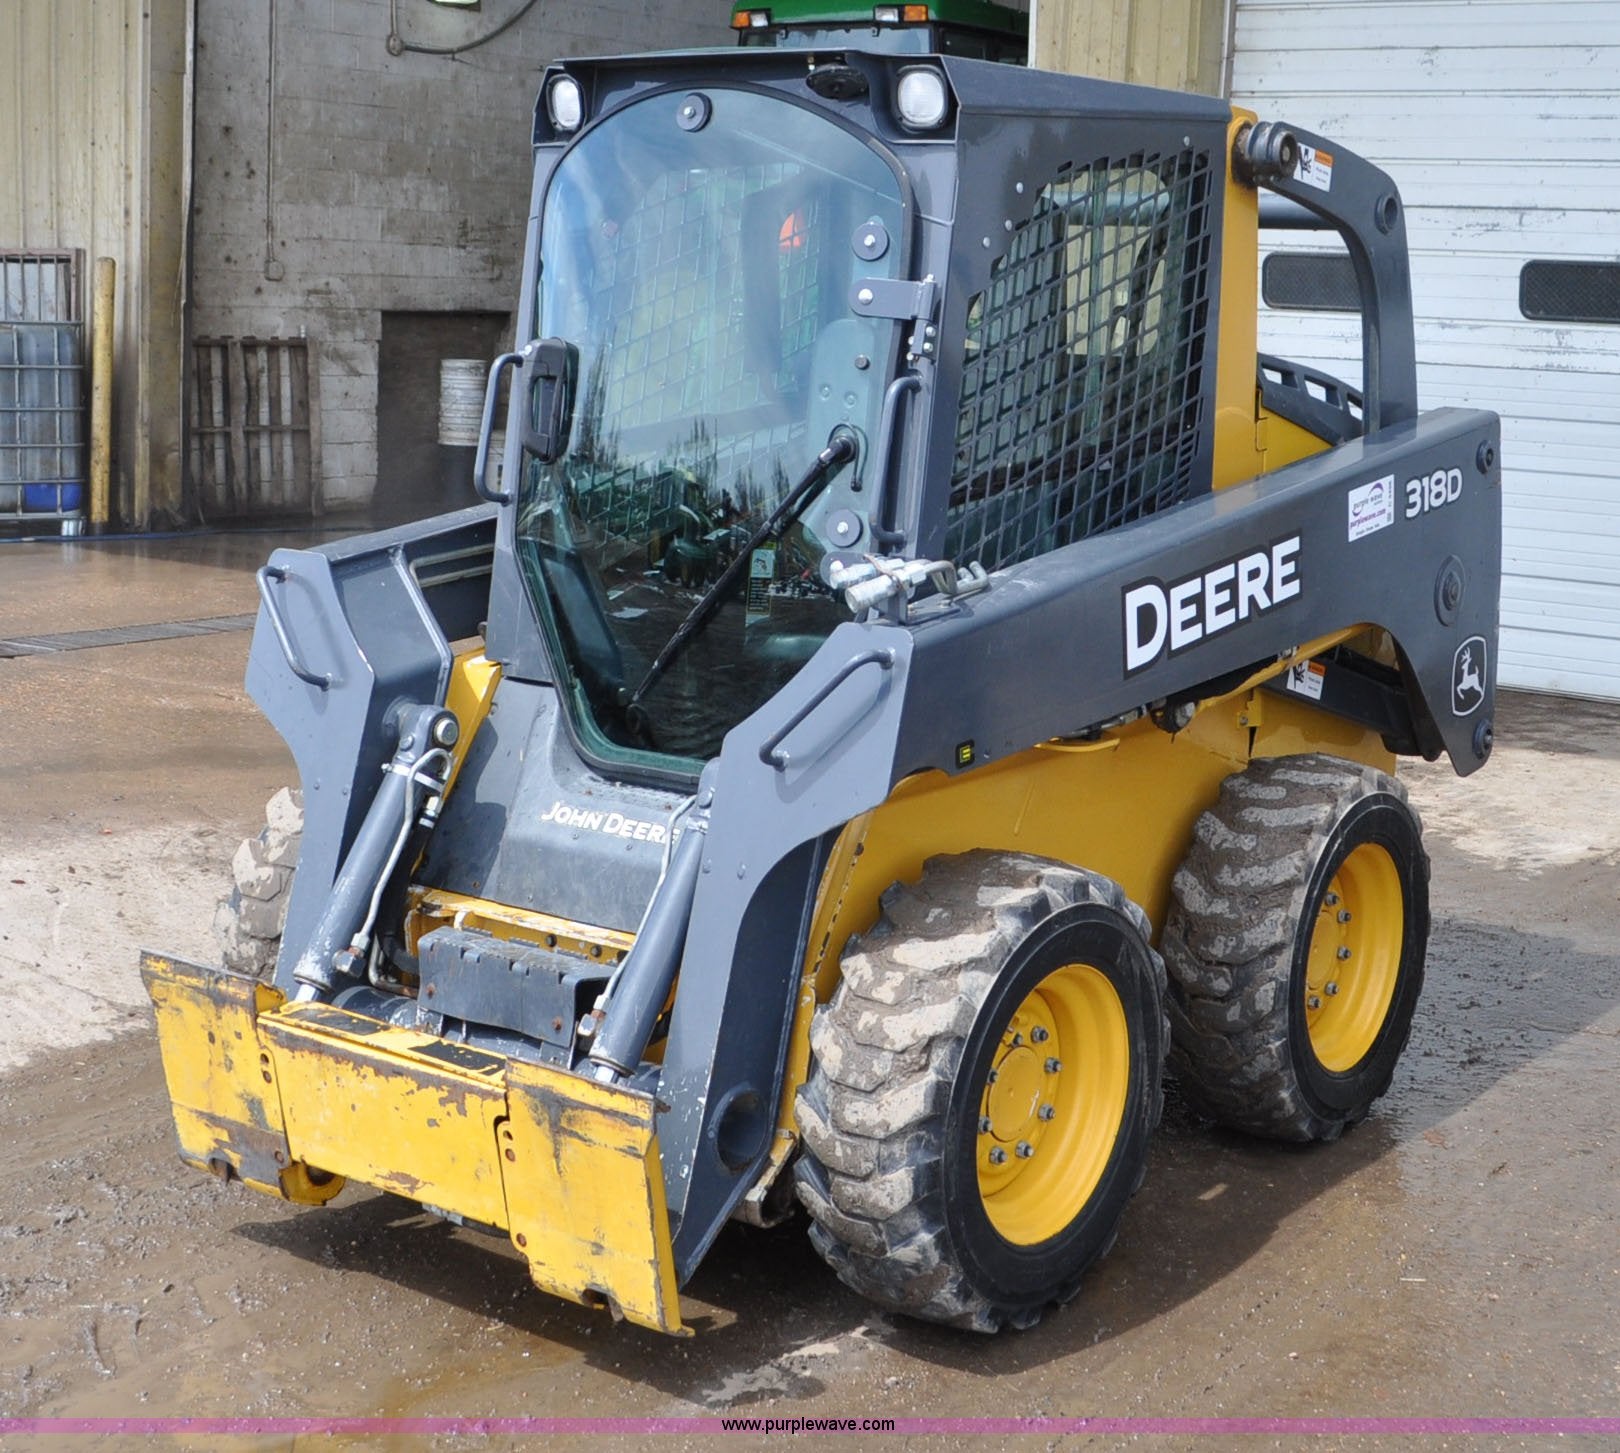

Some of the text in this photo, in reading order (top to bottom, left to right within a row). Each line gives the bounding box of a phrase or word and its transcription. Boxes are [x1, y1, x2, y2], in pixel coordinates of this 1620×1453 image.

[1406, 468, 1462, 518] 318D
[1125, 536, 1300, 671] DEERE
[541, 801, 602, 831] JOHN
